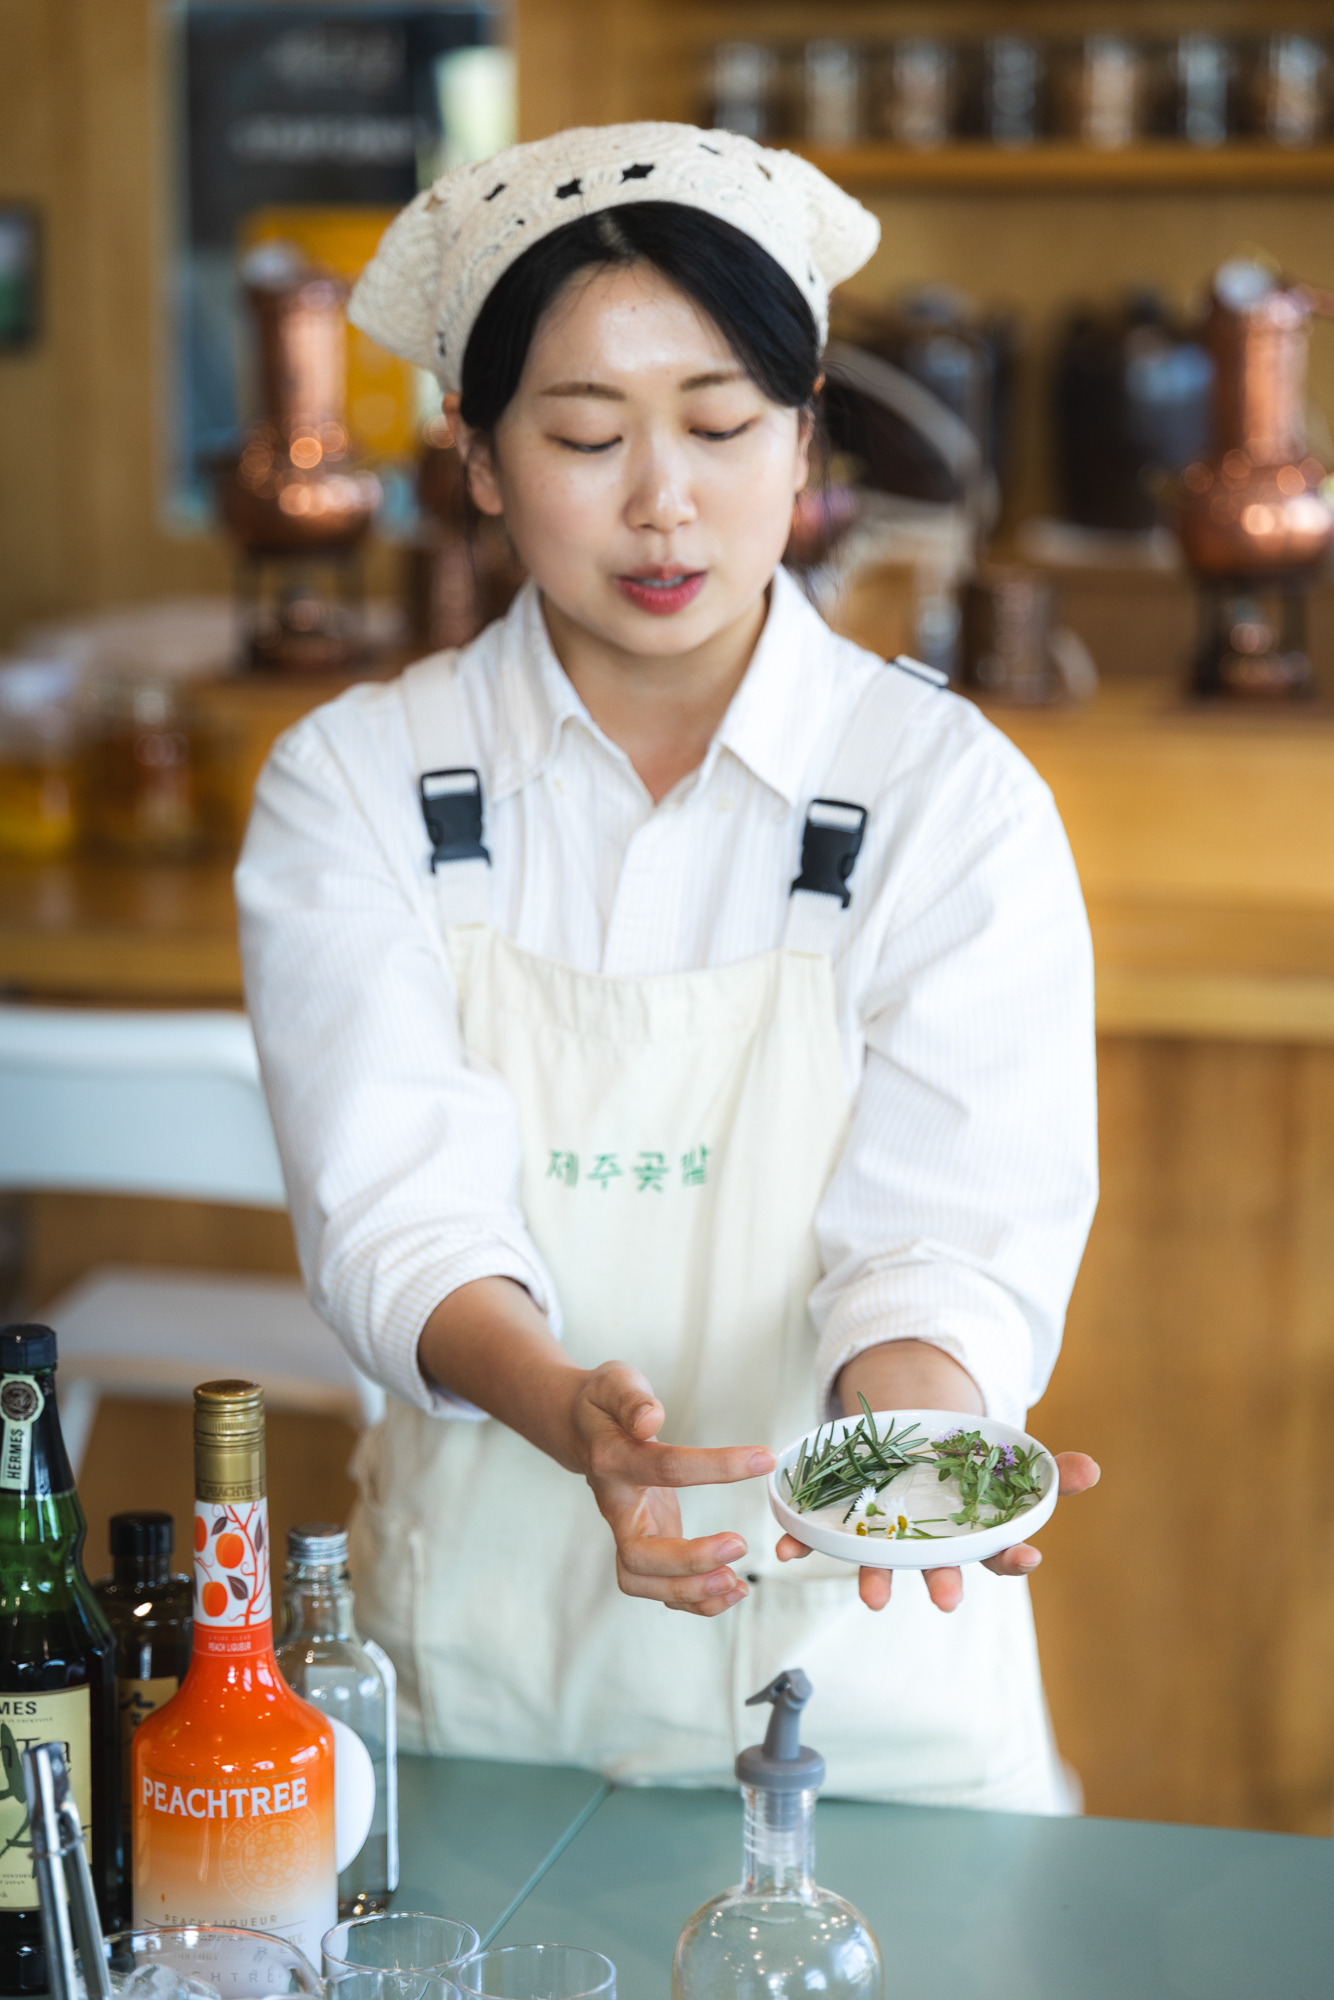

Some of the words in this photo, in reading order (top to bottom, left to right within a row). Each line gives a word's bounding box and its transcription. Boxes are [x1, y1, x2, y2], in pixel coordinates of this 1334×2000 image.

[7, 1429, 24, 1480] HERMES
[208, 1641, 226, 1652] PEACH
[227, 1641, 252, 1653] LIQUEUR
[178, 1774, 196, 1783] THE
[203, 1776, 258, 1785] ORIGINAL
[142, 1776, 308, 1819] PEACHTREE
[164, 1914, 205, 1926] PEACH
